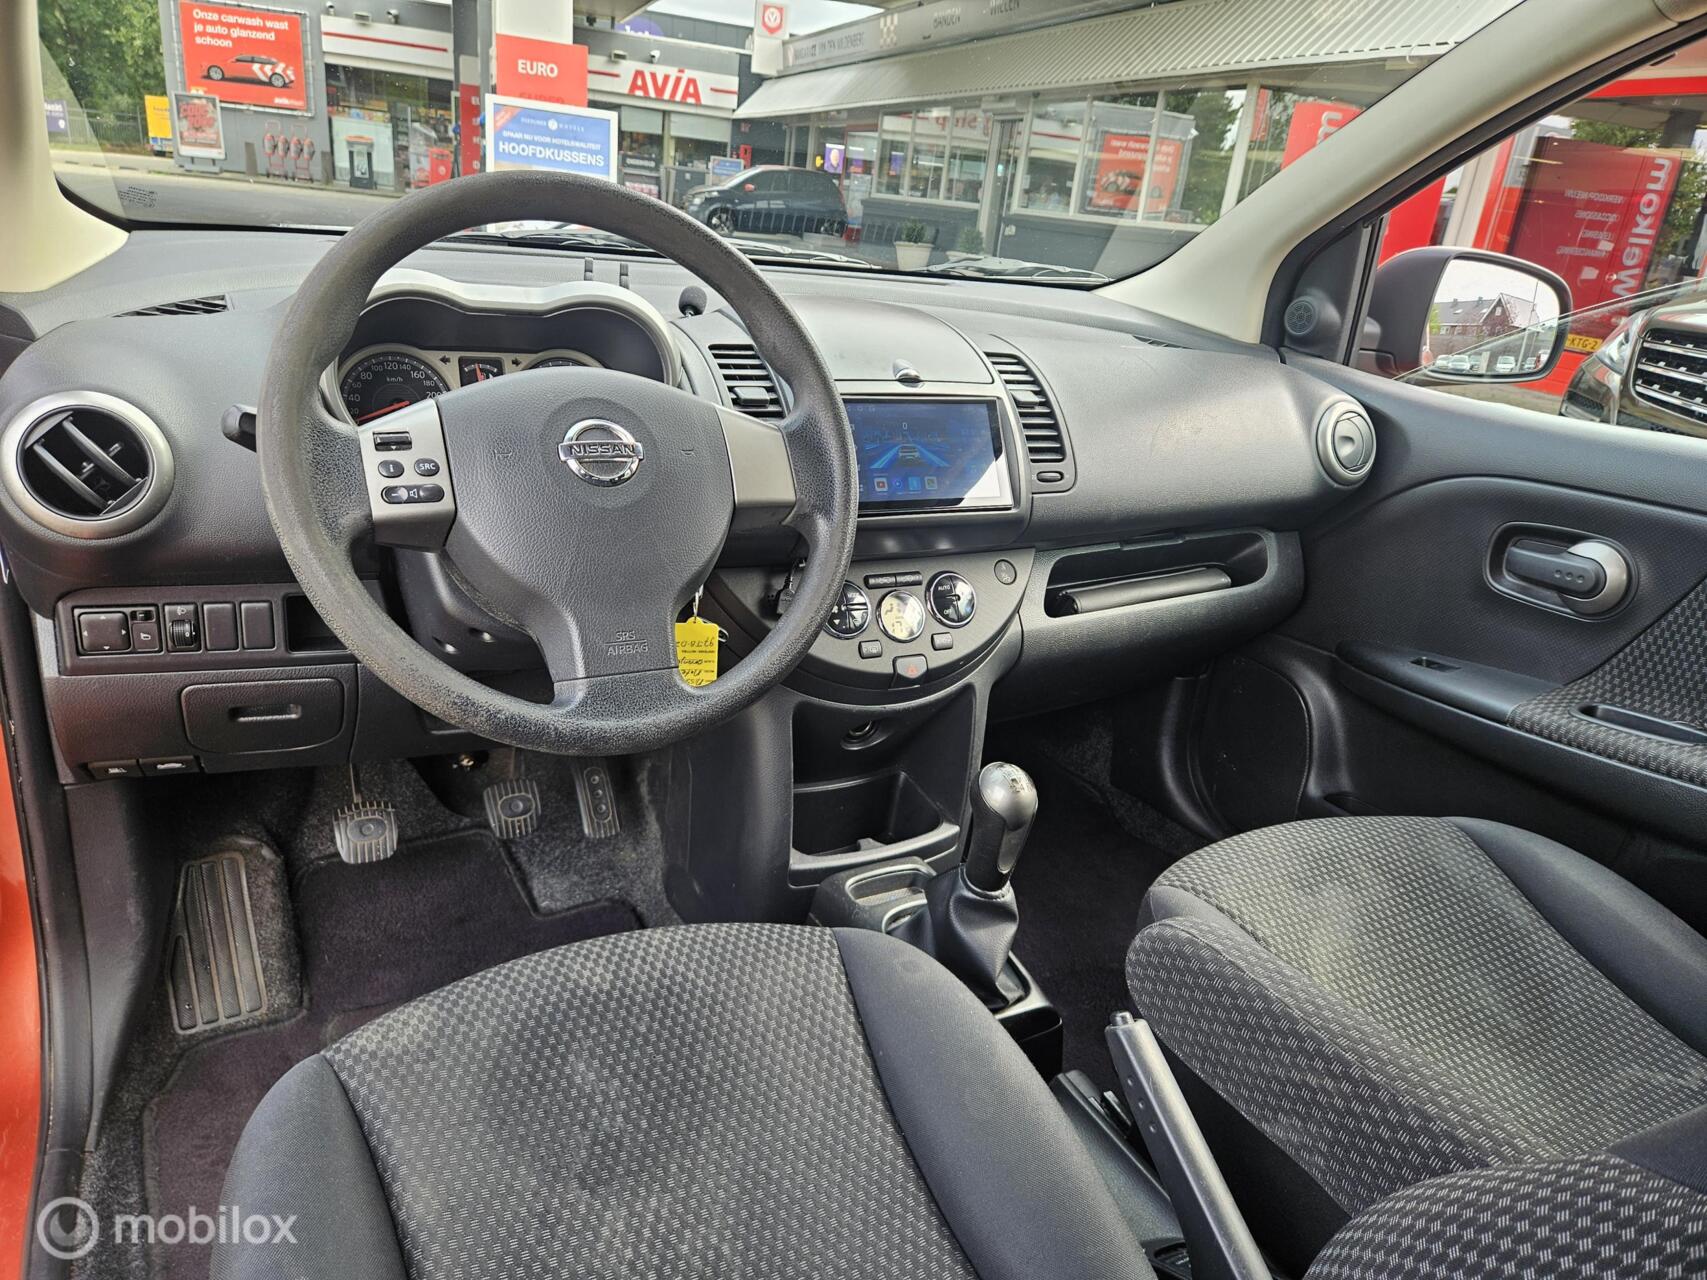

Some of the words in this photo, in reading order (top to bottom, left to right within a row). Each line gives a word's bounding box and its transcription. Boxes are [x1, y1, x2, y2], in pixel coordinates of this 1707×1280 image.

[192, 8, 219, 21] Onze
[220, 13, 264, 26] carwash
[264, 19, 289, 30] wast
[193, 23, 203, 33] je
[205, 24, 228, 35] auto
[229, 27, 276, 41] glanzend
[194, 35, 232, 48] schoon
[517, 58, 559, 78] EURO
[627, 68, 703, 106] AVIA
[502, 129, 523, 140] SPAAR
[523, 132, 533, 141] NU
[533, 133, 552, 143] VOOR
[498, 140, 605, 168] HOOFDKUSSENS
[371, 364, 383, 372] 100
[384, 361, 398, 370] 120
[360, 372, 373, 380] 80
[411, 371, 425, 379] 160
[348, 393, 360, 402] 40
[570, 443, 636, 456] NISSAN
[419, 463, 436, 471] SRC
[615, 630, 636, 641] SRS
[607, 642, 649, 656] AIRBAG
